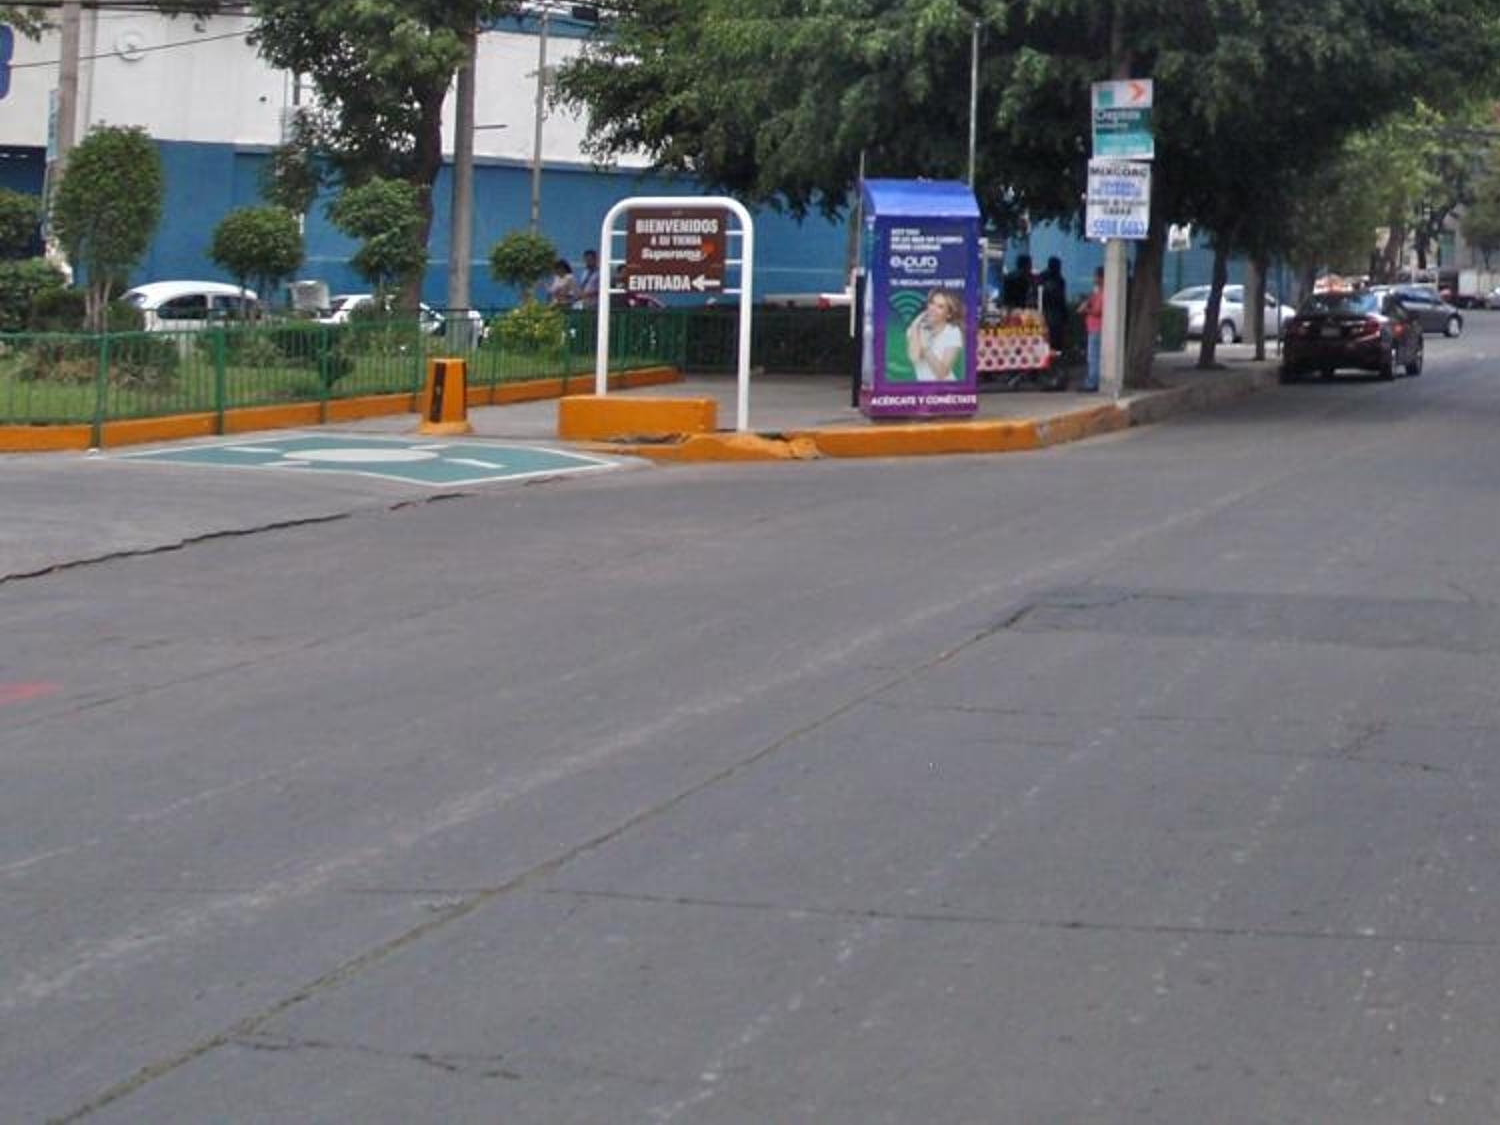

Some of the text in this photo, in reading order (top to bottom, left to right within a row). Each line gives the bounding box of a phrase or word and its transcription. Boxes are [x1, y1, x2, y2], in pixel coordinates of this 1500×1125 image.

[635, 219, 719, 234] BIENVENIDOS
[672, 235, 702, 246] TIENDA
[628, 274, 691, 290] ENTRADA
[917, 395, 924, 405] Y
